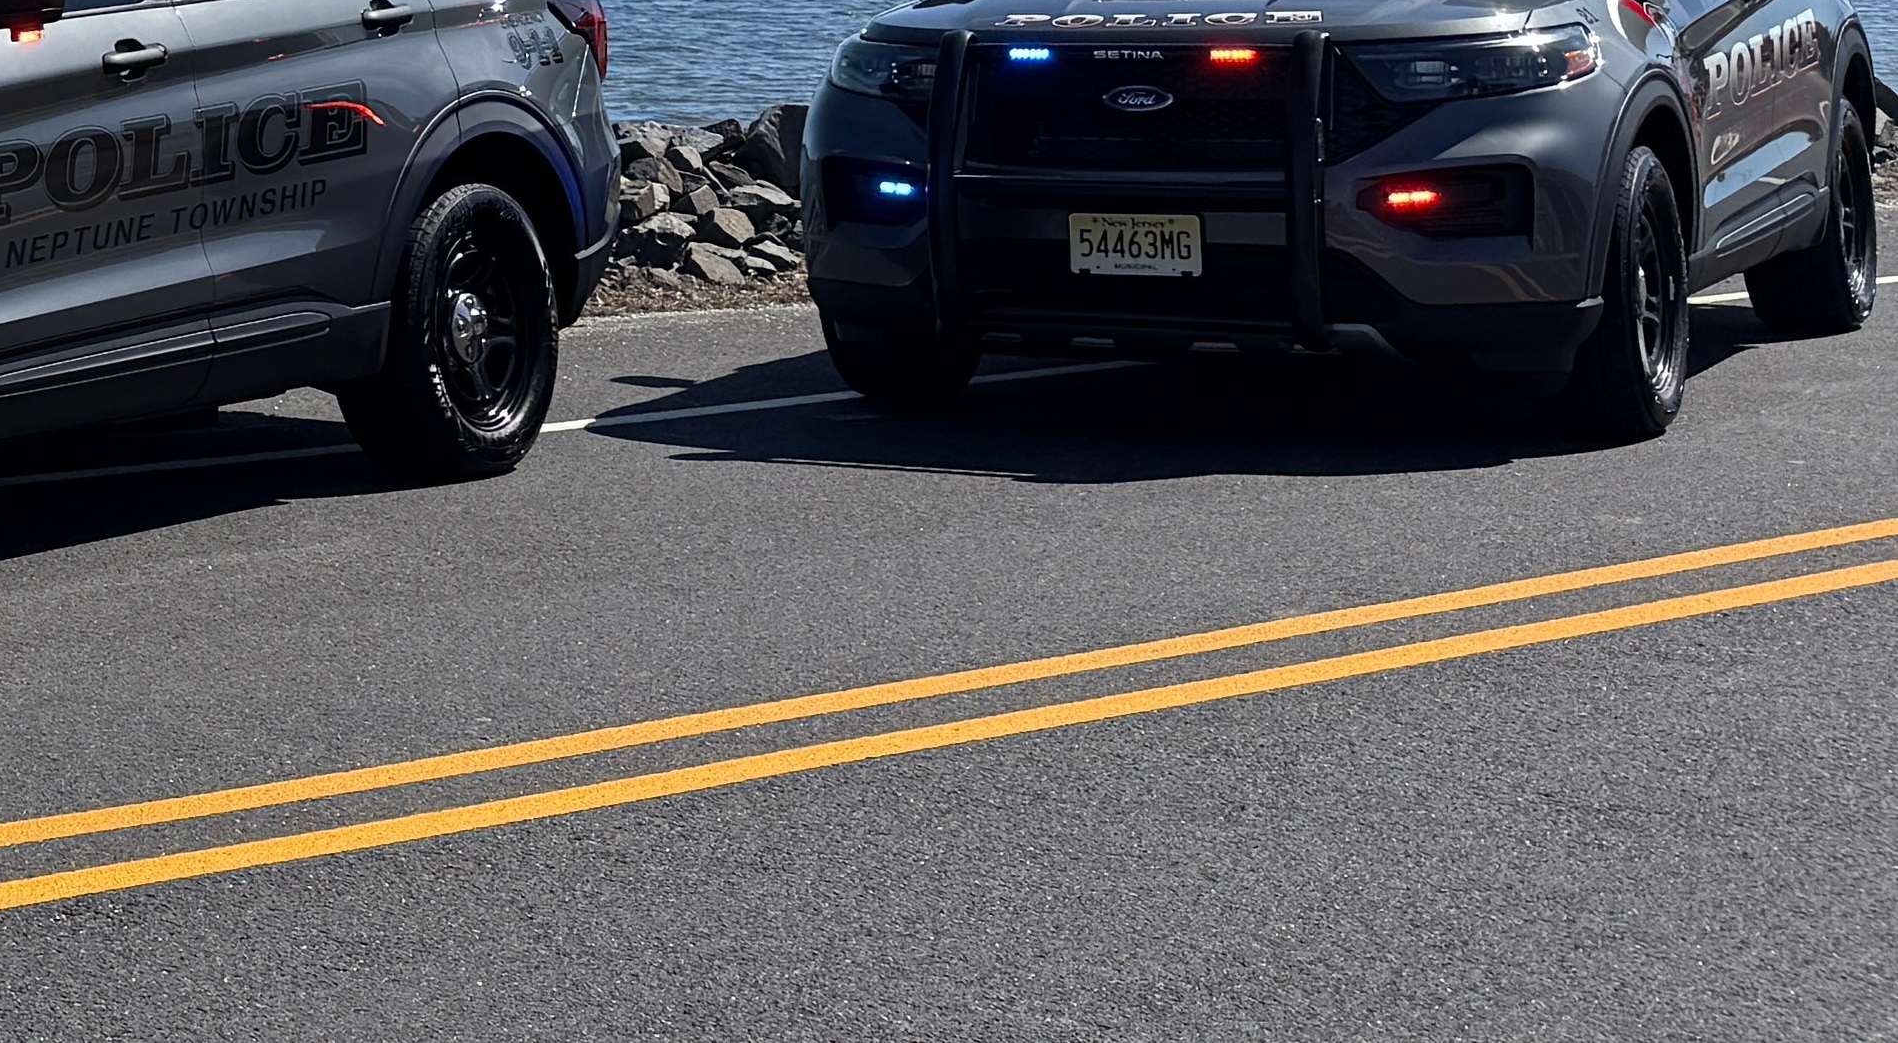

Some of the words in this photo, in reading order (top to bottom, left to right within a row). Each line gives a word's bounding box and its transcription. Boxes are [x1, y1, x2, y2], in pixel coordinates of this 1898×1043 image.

[994, 10, 1323, 28] POLICE
[1093, 49, 1164, 60] SETINA
[1703, 8, 1821, 120] POLICE
[1117, 91, 1156, 106] Ford
[4, 211, 155, 269] NEPTUNE
[170, 178, 327, 231] TOWNSHIP
[1079, 228, 1192, 260] 54463MG
